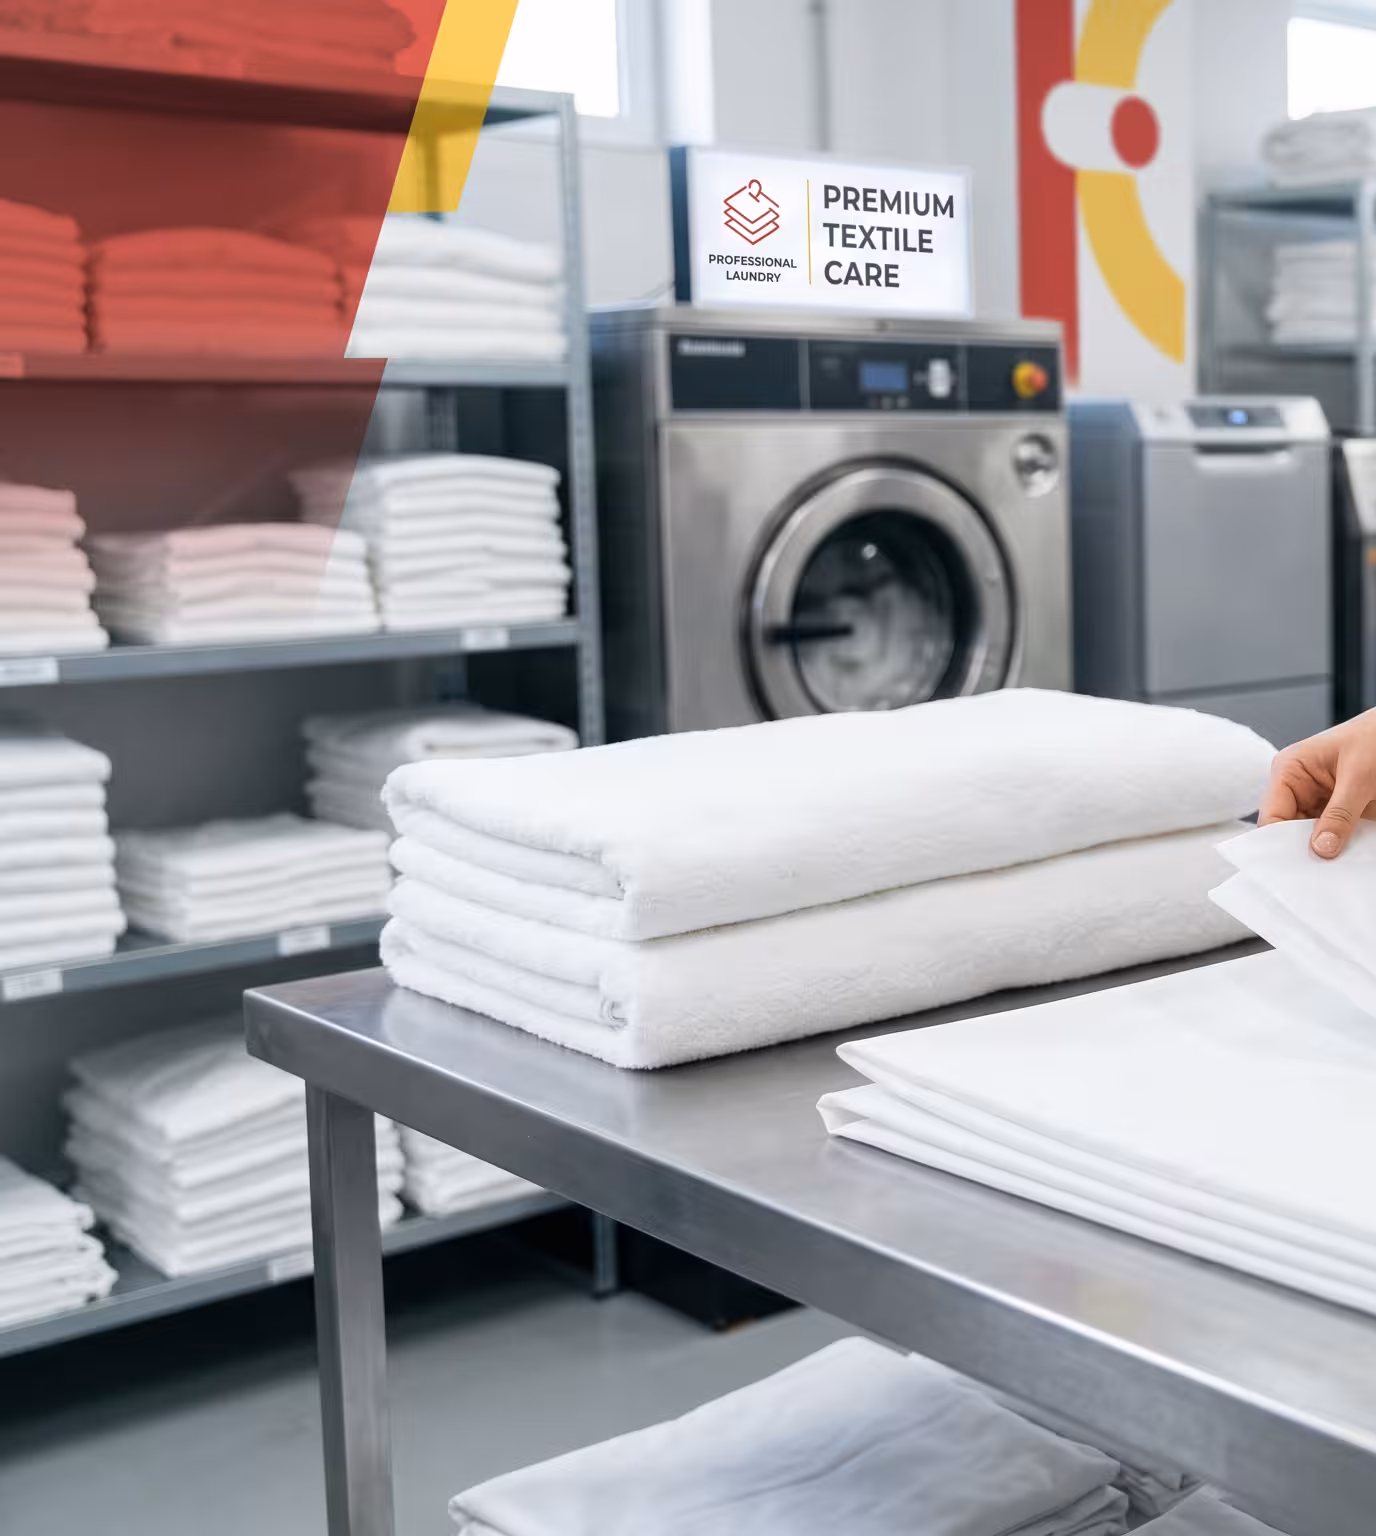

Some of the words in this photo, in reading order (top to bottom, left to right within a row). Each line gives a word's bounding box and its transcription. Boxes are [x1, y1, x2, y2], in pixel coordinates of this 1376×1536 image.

[823, 184, 955, 219] PREMIUM
[822, 223, 934, 254] TEXTILE
[708, 254, 798, 270] PROFESSIONAL
[823, 260, 901, 288] CARE
[725, 270, 782, 283] LAUNDRY
